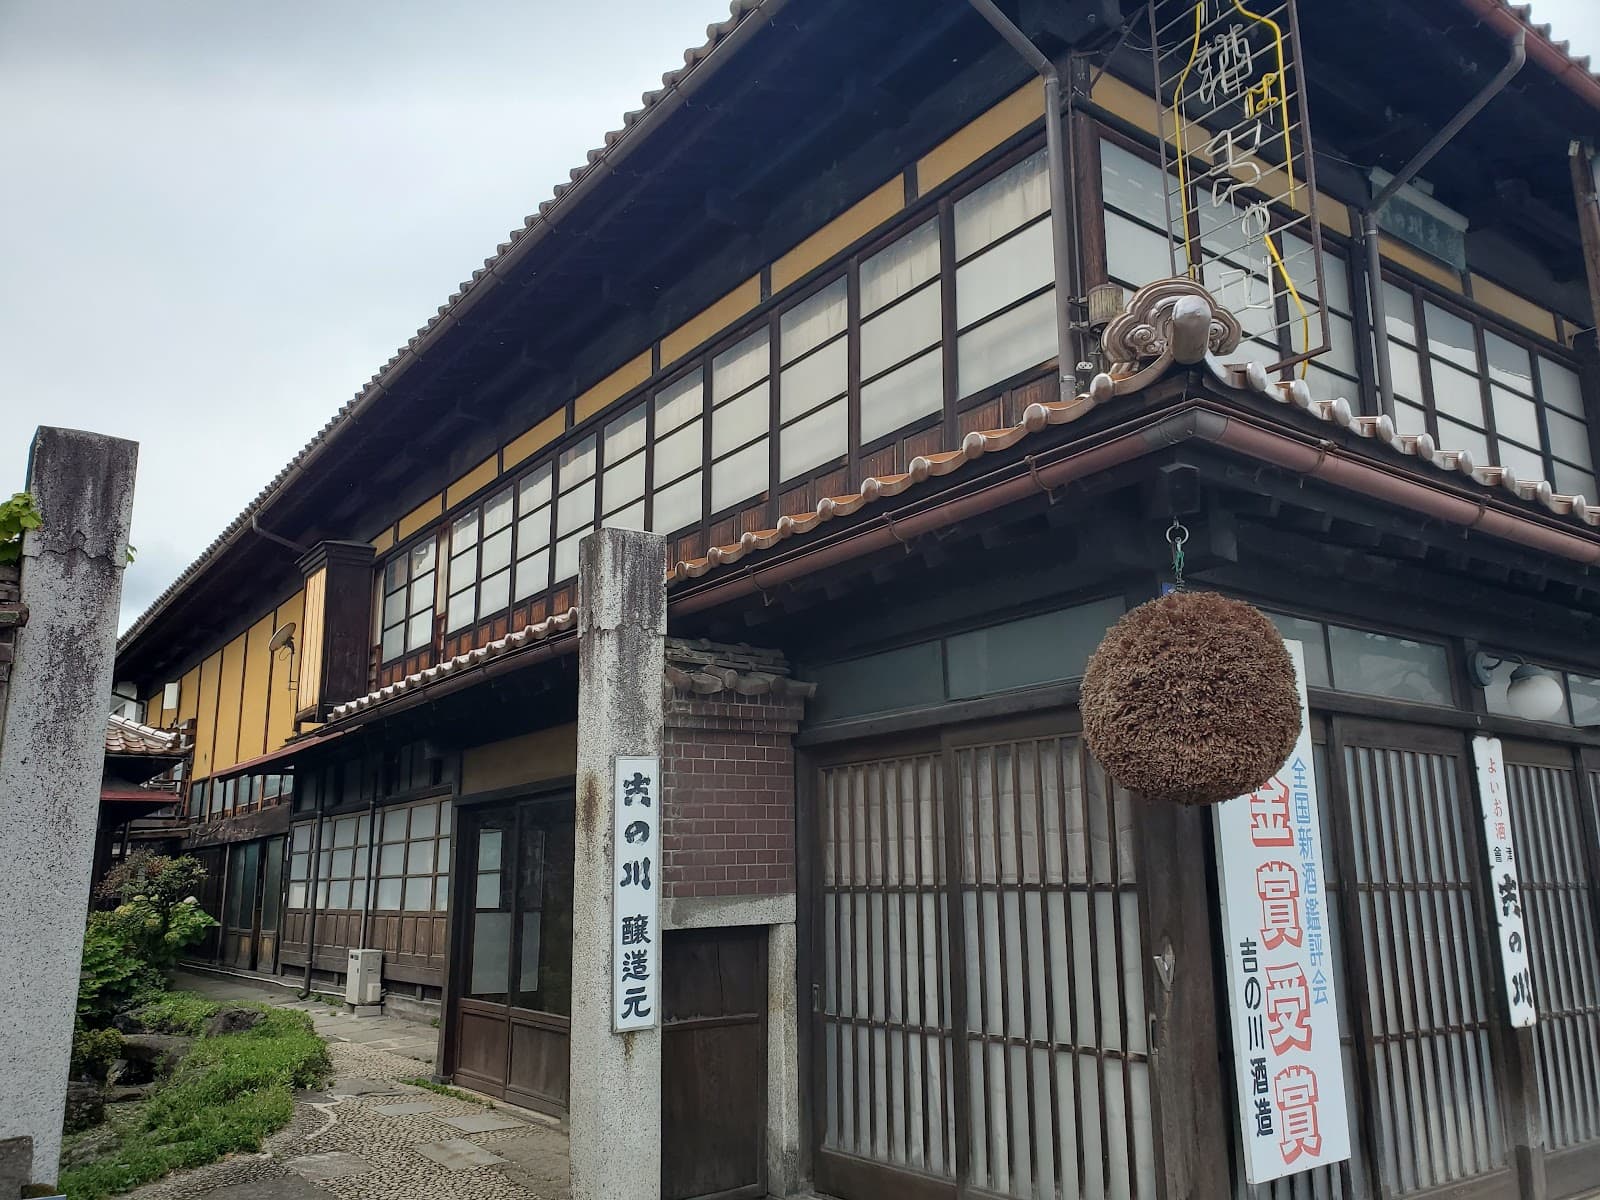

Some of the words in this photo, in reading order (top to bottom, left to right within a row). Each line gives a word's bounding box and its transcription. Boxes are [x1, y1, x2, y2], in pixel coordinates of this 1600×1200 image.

[1248, 775, 1323, 1166] 金賞受賞
[1291, 757, 1329, 1005] 全国新酒鑑評会
[1239, 937, 1274, 1138] 吉の川酒造
